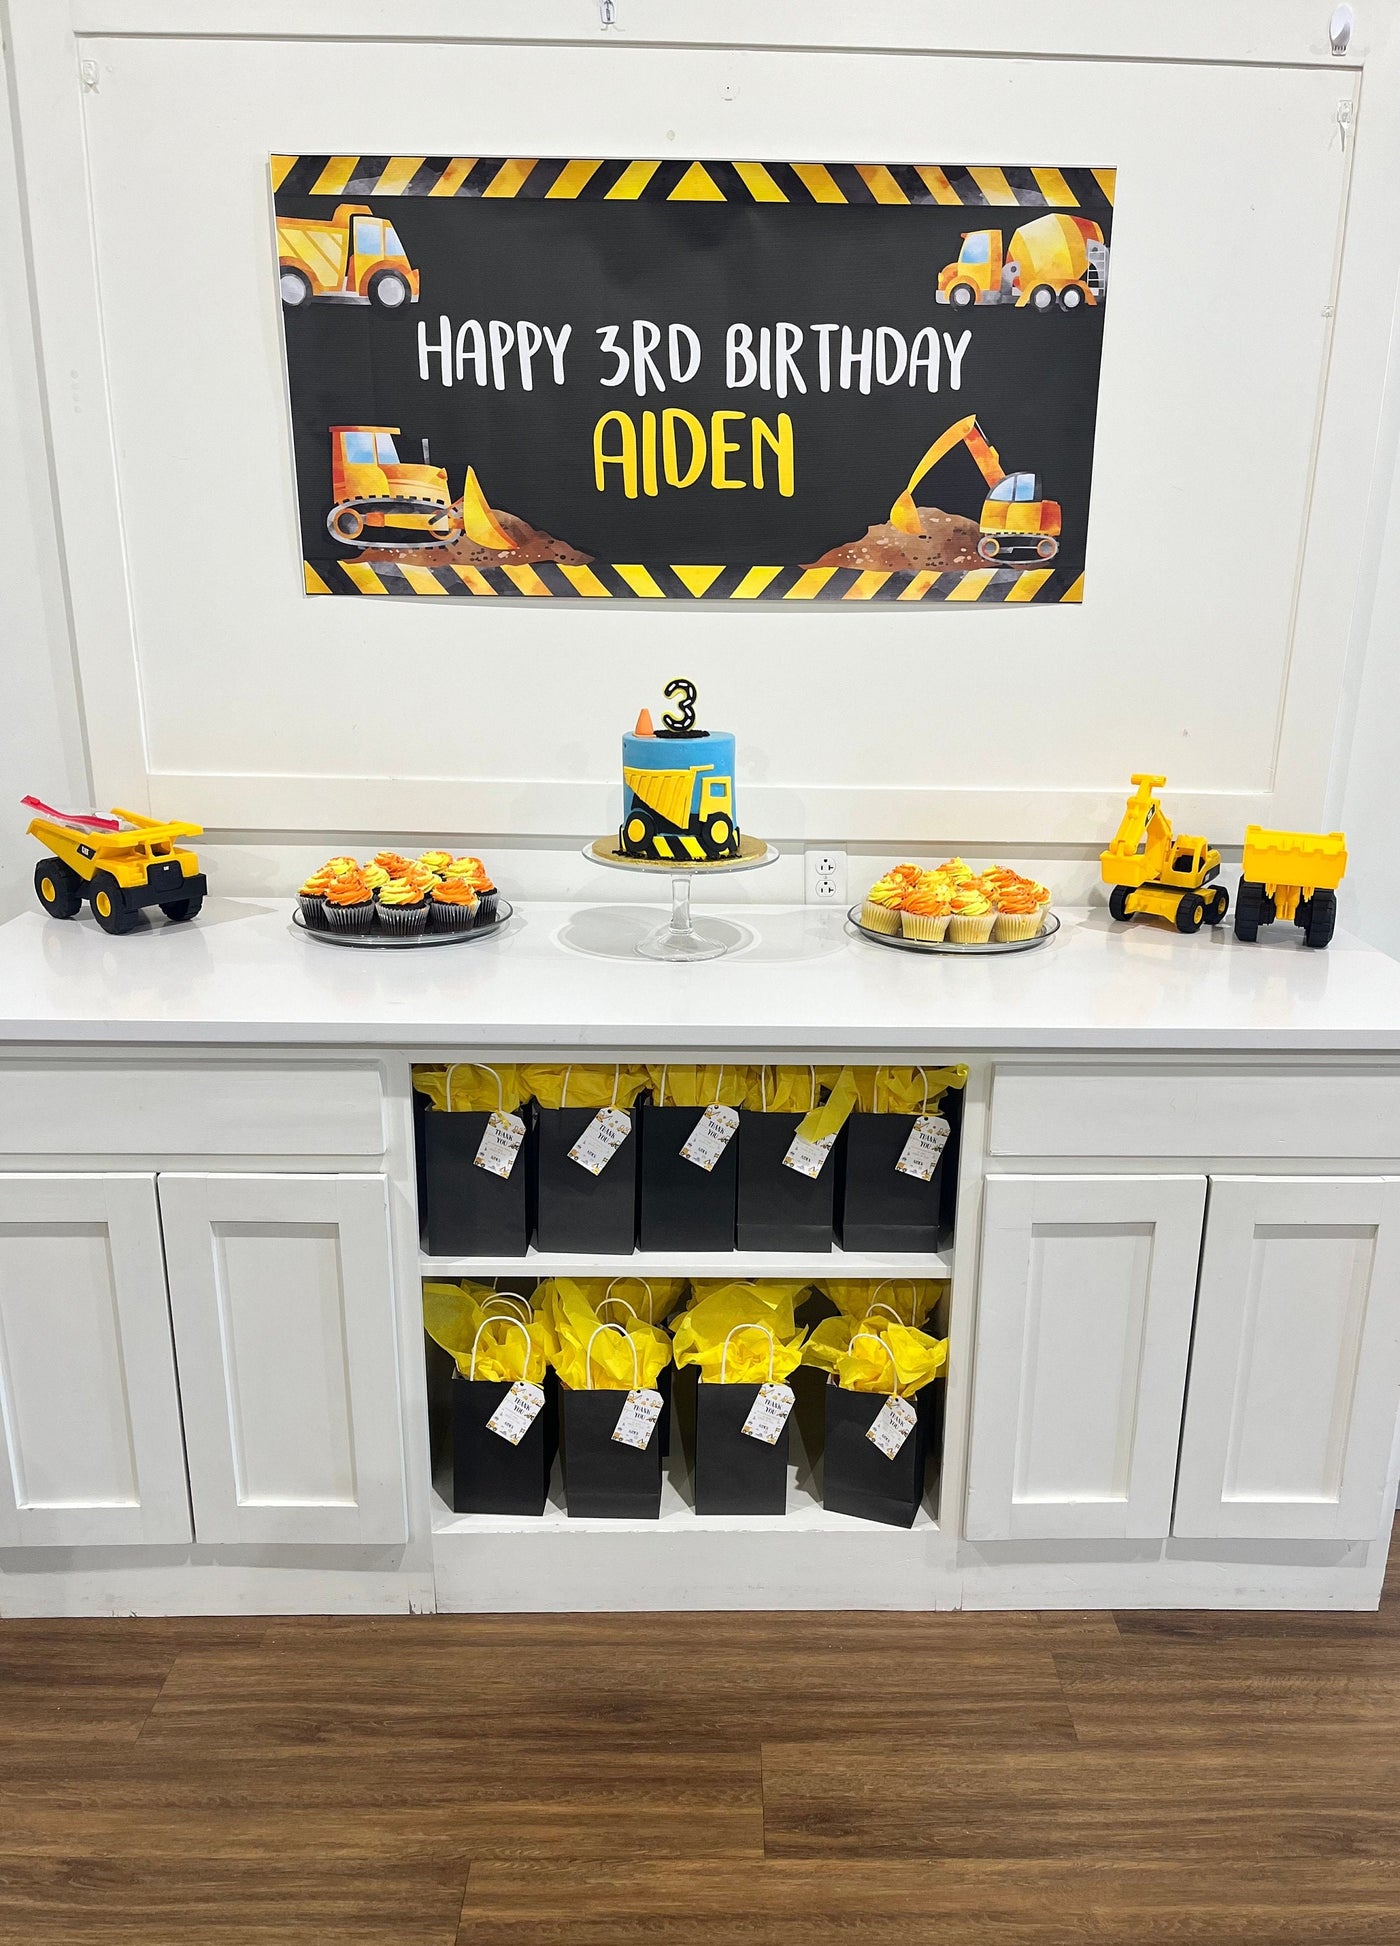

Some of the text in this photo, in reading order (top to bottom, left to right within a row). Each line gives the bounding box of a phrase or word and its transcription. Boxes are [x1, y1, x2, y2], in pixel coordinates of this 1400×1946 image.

[417, 314, 973, 399] HAPPY 3RD BIRTHDAY
[593, 407, 795, 500] AIDEN
[662, 678, 698, 732] 3
